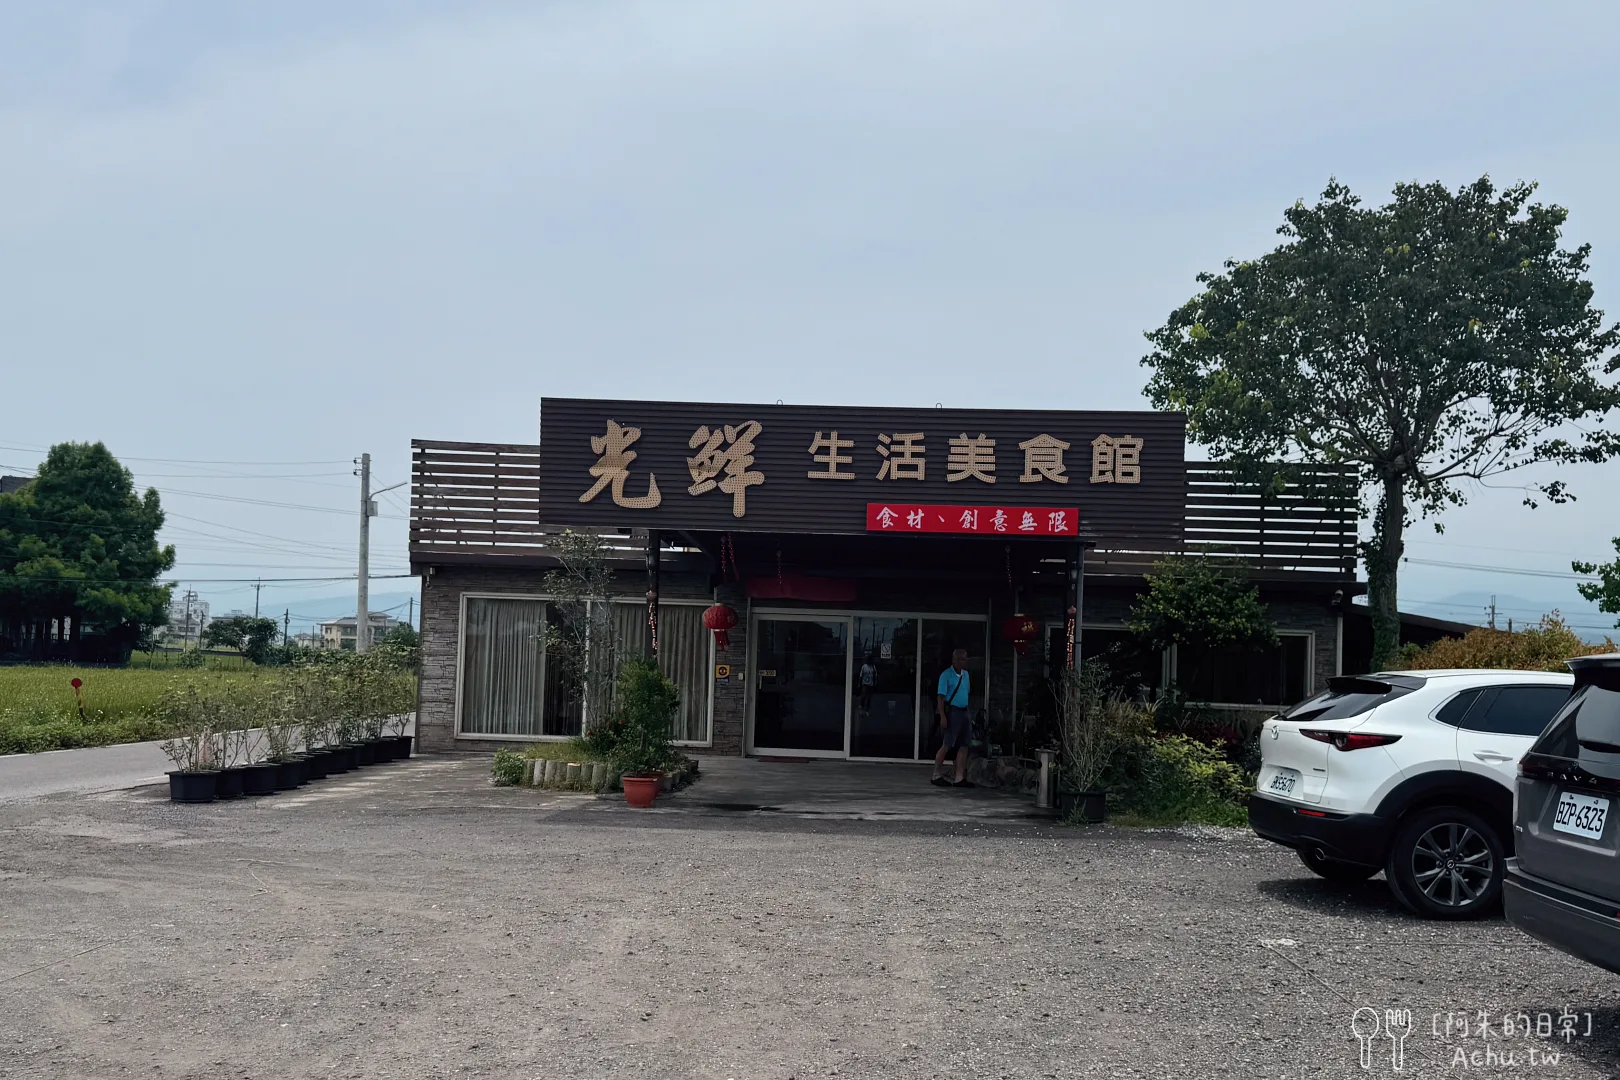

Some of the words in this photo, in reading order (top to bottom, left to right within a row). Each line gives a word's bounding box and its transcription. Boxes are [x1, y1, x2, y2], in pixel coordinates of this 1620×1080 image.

[578, 419, 765, 518] 光鮮
[807, 431, 1143, 484] 生活美食館
[1555, 801, 1606, 832] BZP-6323
